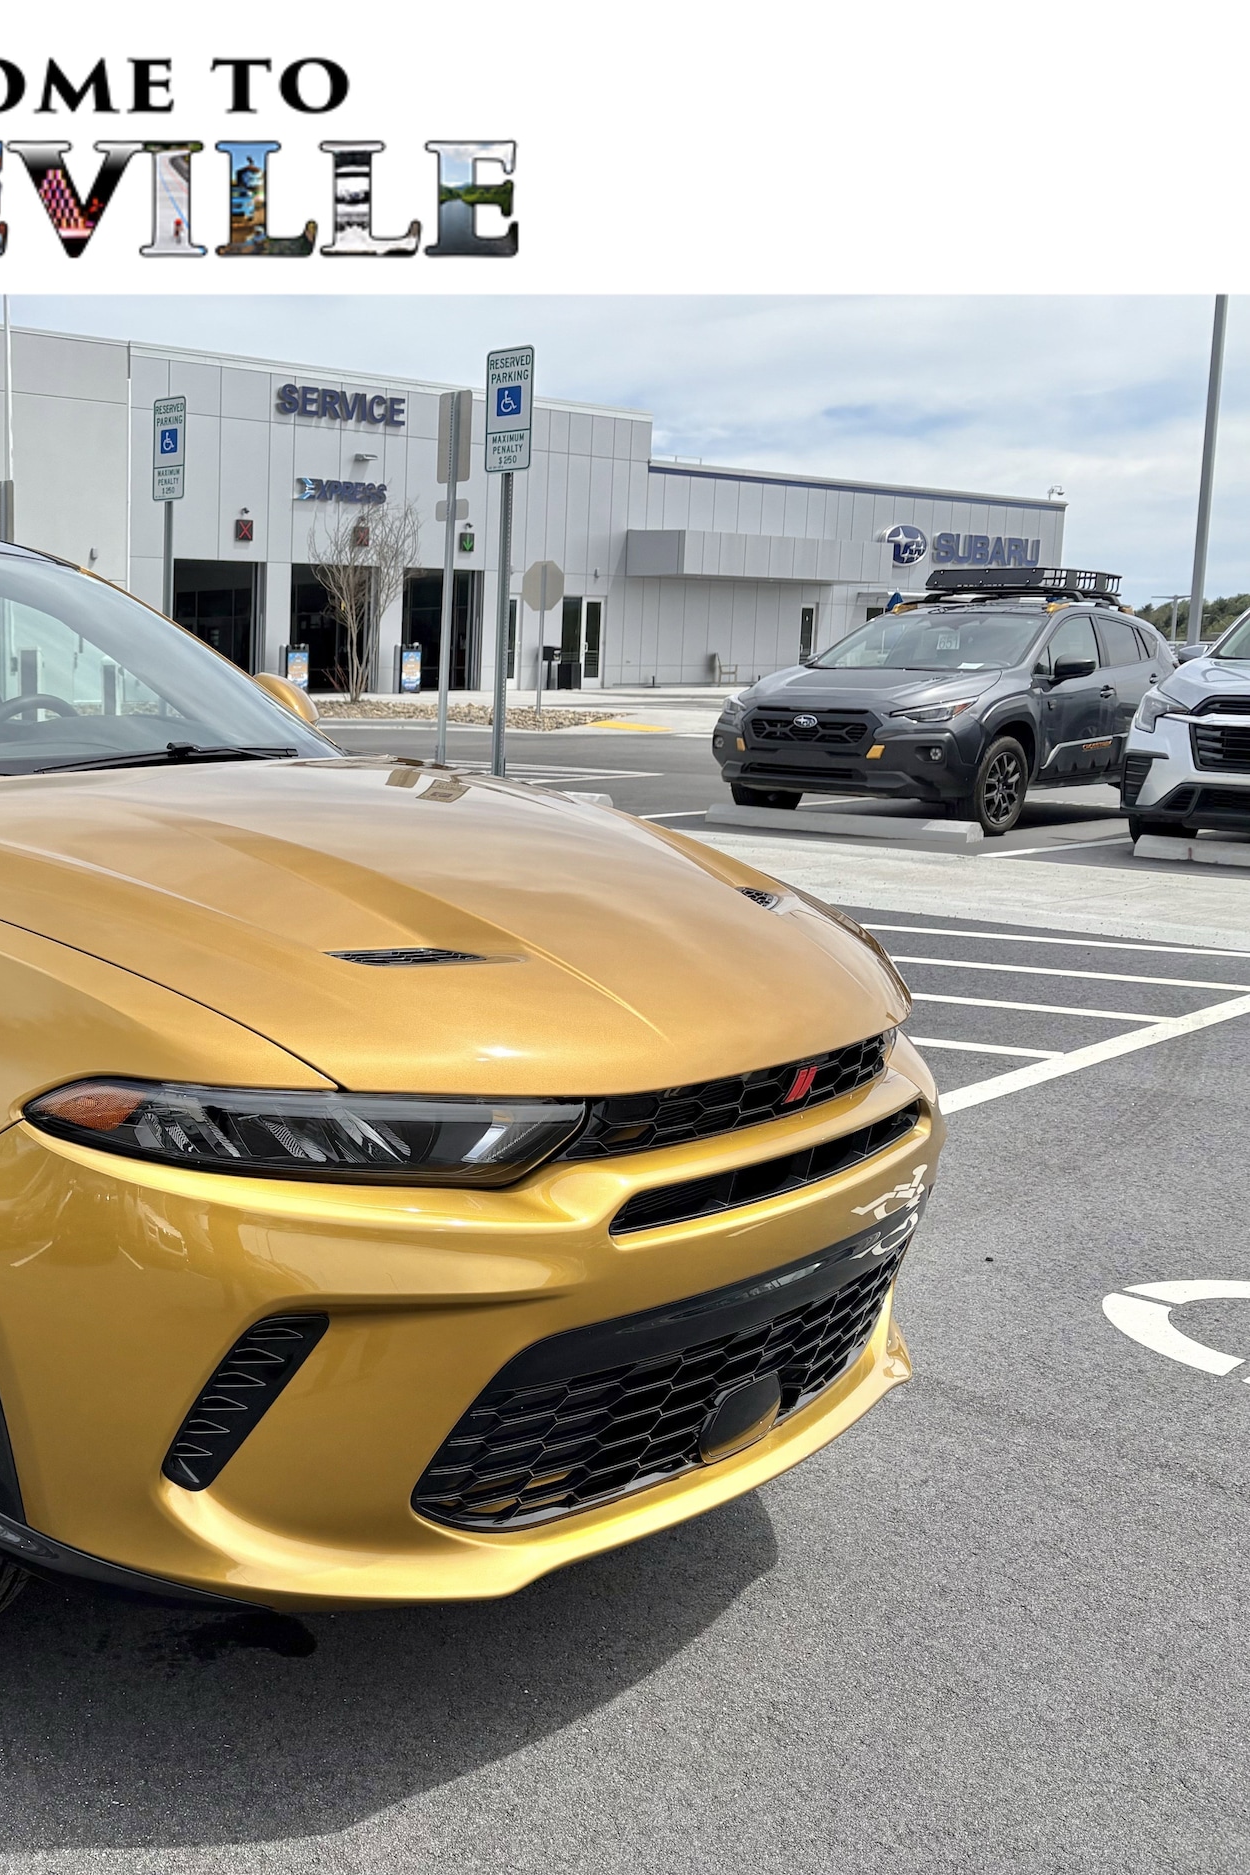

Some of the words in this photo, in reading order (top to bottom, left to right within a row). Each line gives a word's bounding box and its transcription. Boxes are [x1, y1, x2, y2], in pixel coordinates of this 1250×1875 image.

[490, 355, 531, 370] RESERVED
[491, 370, 529, 384] PARKING
[155, 403, 184, 415] RESERVED
[276, 383, 406, 426] SERVICE
[157, 415, 183, 427] PARKING
[492, 433, 525, 444] MAXIMUM
[492, 444, 523, 455] PENALTY
[933, 532, 1041, 567] SUBARU
